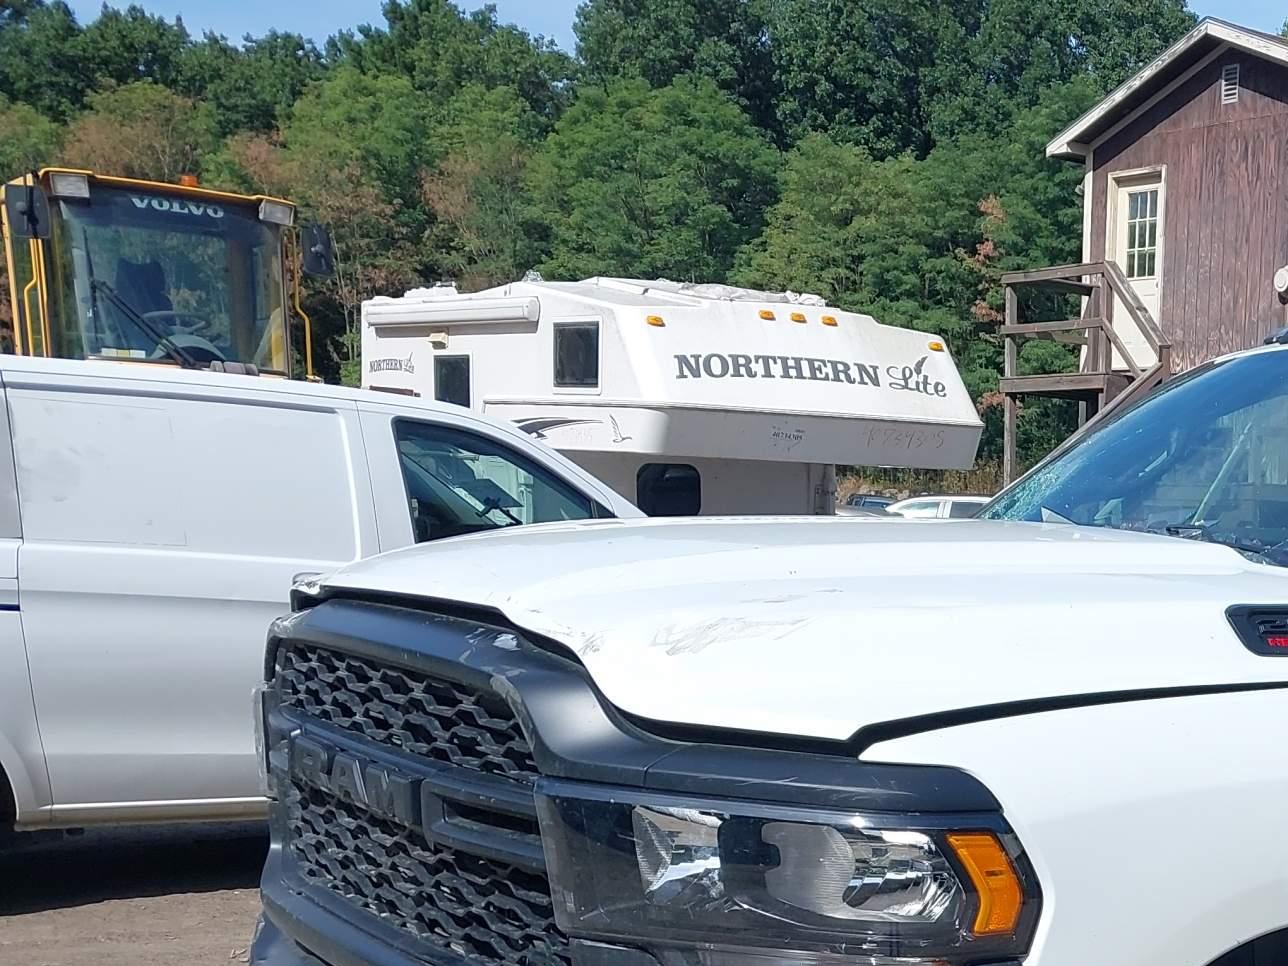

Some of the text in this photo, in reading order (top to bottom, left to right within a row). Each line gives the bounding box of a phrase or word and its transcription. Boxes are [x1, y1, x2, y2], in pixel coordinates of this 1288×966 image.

[131, 196, 225, 218] VOLVO
[369, 358, 403, 374] NORTHERN
[673, 352, 948, 398] NORTHERN Lite
[289, 731, 422, 826] RAM
